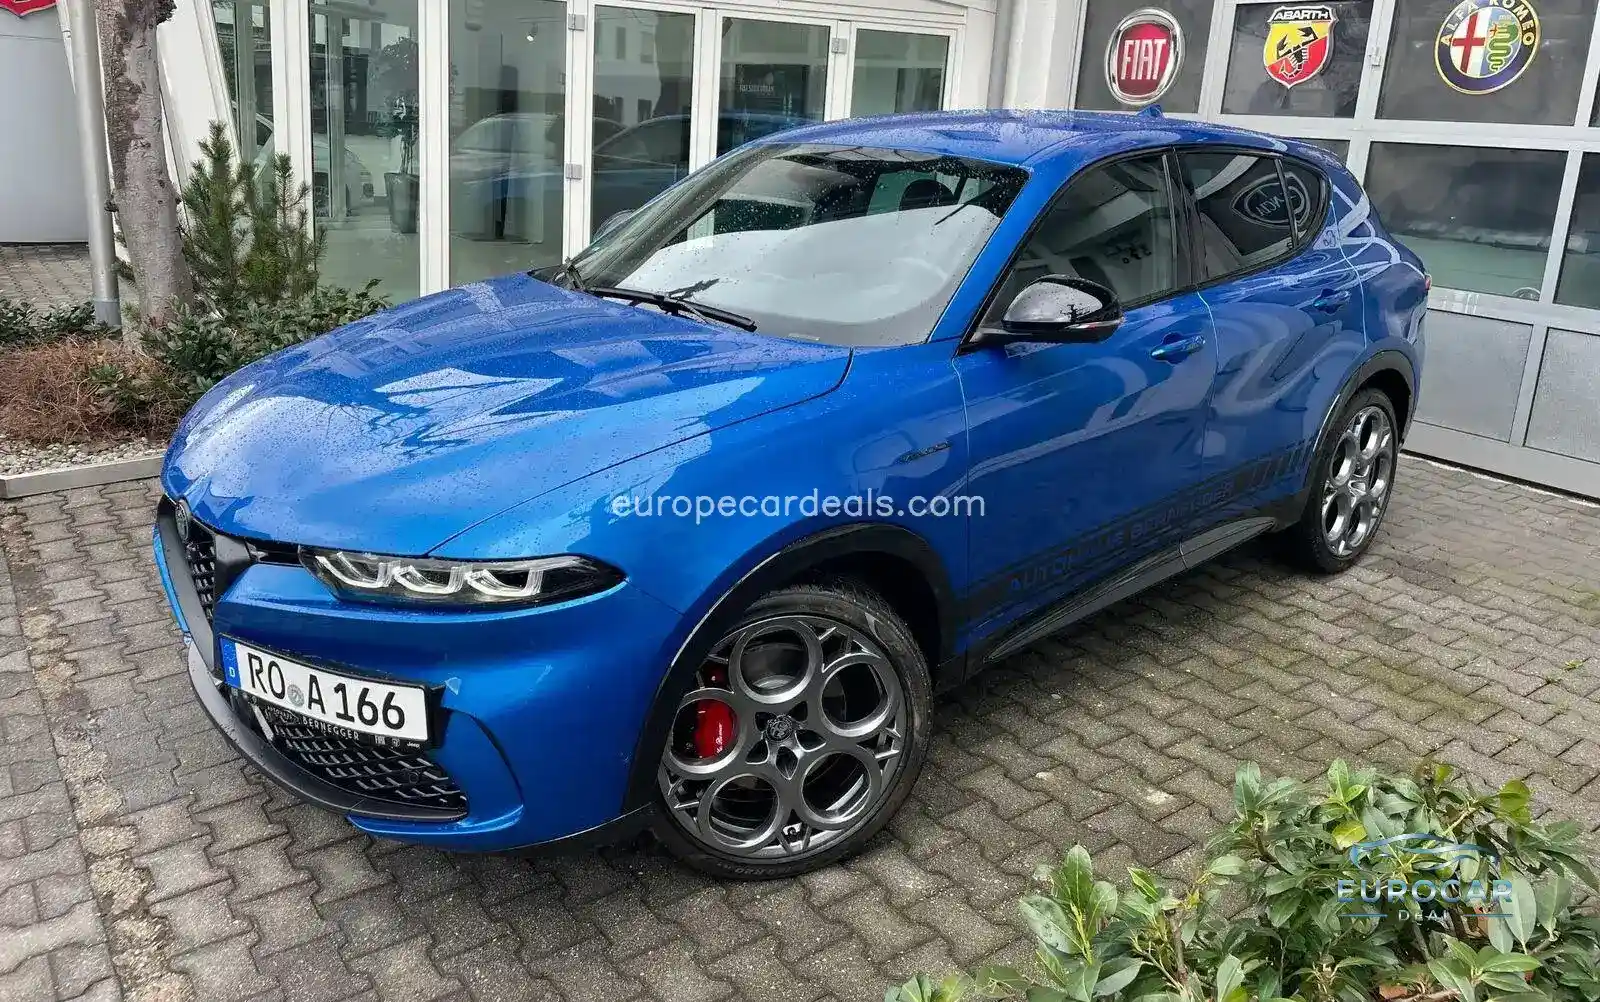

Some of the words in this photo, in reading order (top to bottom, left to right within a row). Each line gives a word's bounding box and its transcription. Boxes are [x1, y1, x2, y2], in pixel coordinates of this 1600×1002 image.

[1273, 9, 1330, 21] ABARTH
[1120, 38, 1168, 80] FIAT
[229, 667, 236, 678] D
[247, 652, 287, 700] RO
[307, 673, 327, 716] A
[333, 682, 406, 731] 166
[302, 715, 360, 741] BERNEGGER
